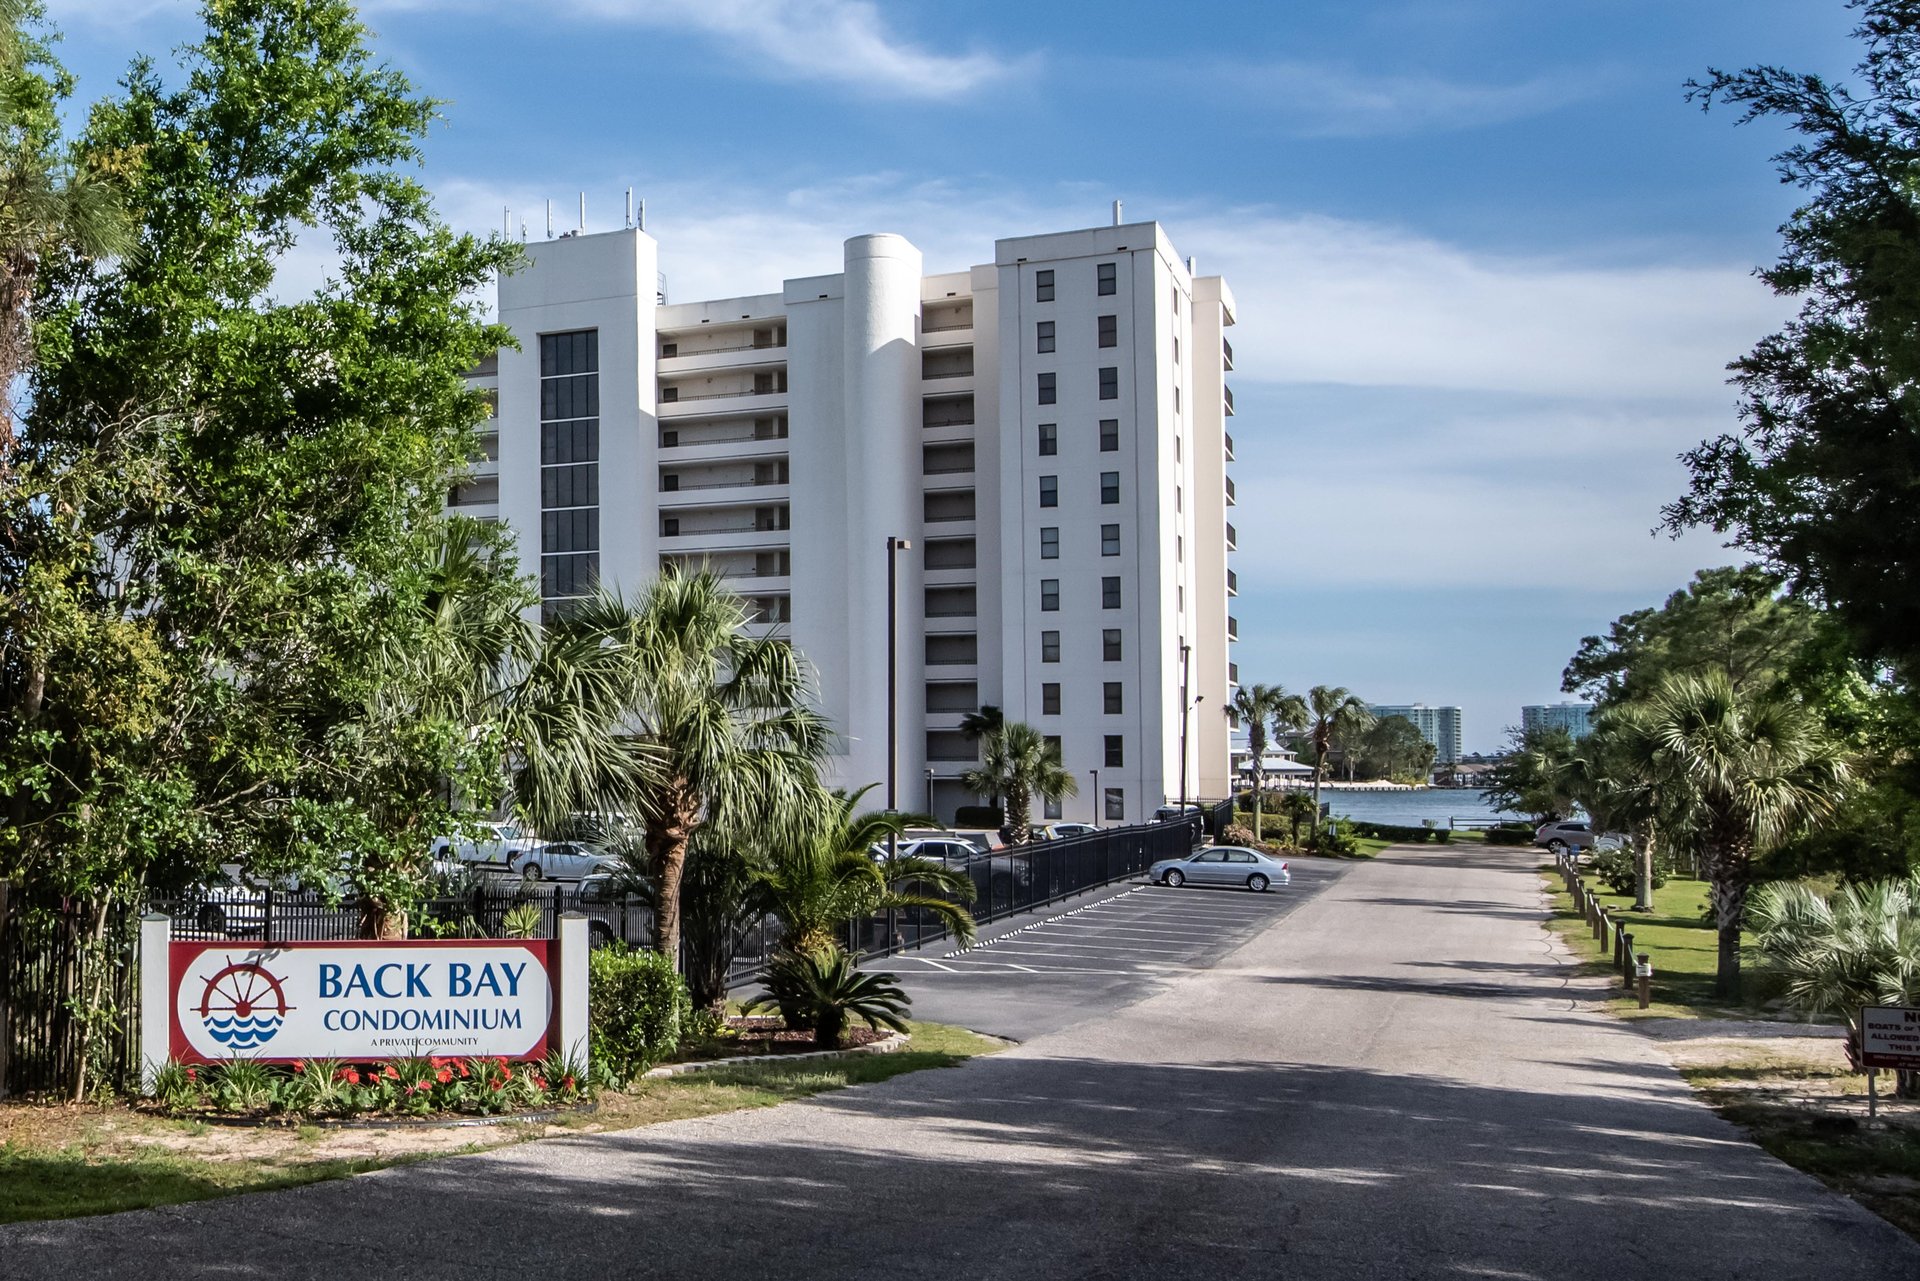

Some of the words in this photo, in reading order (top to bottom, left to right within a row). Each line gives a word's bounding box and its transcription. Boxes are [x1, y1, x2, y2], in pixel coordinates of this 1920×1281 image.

[319, 963, 433, 998] BACK
[448, 962, 527, 997] BAY
[323, 1008, 522, 1031] CONDOMINIUM
[1867, 1022, 1901, 1031] BOATS
[371, 1038, 378, 1046] A
[380, 1038, 416, 1046] PRIVATE
[418, 1037, 479, 1046] COMMUNITY
[1871, 1033, 1919, 1042] ALLOWED
